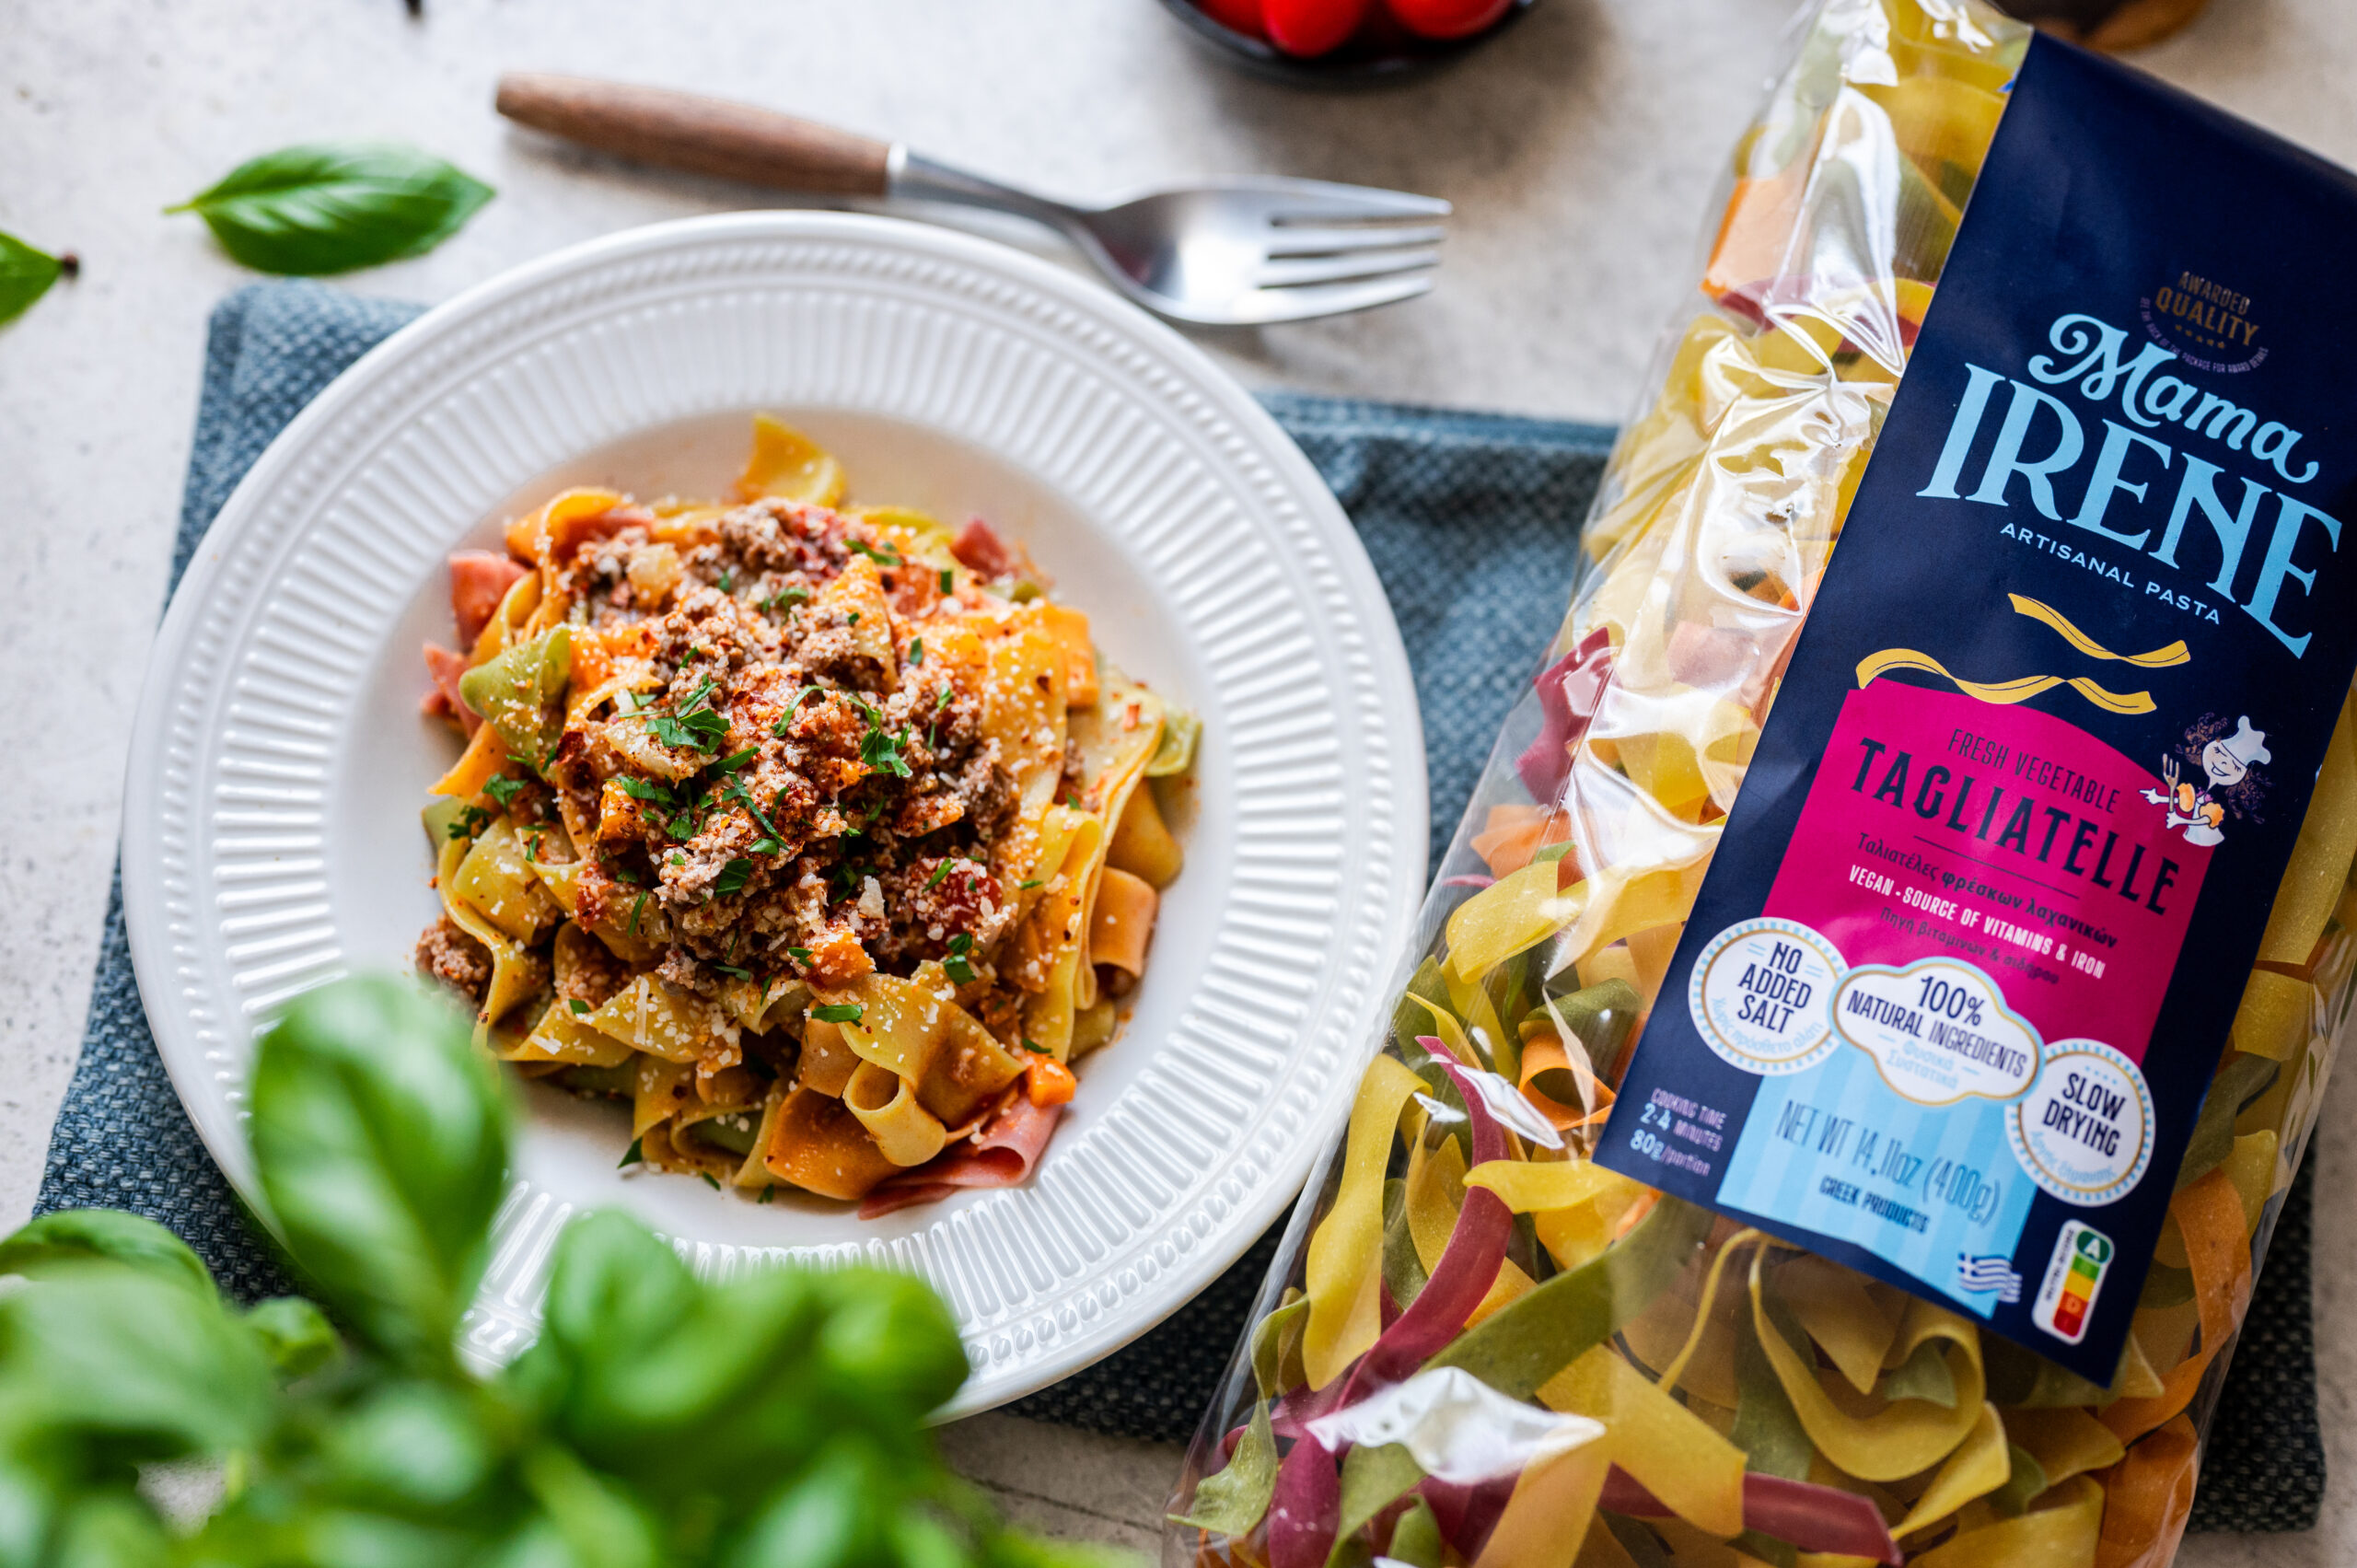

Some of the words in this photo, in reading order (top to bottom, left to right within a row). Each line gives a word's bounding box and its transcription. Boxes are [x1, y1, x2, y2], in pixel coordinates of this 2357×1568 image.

[2155, 287, 2259, 346] QUALITY
[2178, 271, 2250, 315] AWARDED
[2027, 313, 2319, 483] Mama
[1915, 363, 2343, 660] IRENE
[2001, 522, 2135, 588] ARTISANAL
[2145, 581, 2221, 624] PASTA
[1947, 727, 2008, 771] FRESH
[2015, 750, 2120, 814] VEGETABLE
[1851, 737, 2180, 916] TAGLIATELLE
[1856, 831, 1938, 881] Ταλιατέλες
[1941, 870, 2024, 910] φρέσκων
[2026, 898, 2118, 949] λαχανικών
[1848, 865, 1895, 897] VEGAN
[1902, 887, 1958, 921] SOURCE
[1960, 908, 1981, 928] OF
[1983, 915, 2053, 956] VITAMINS
[2055, 944, 2068, 962] &
[2071, 950, 2107, 979] IRON
[1768, 941, 1803, 974] NO
[1989, 947, 2000, 961] &
[1737, 963, 1812, 1008] ADDED
[1918, 976, 1984, 1027] 100%
[1737, 994, 1794, 1033] SALT
[1847, 990, 1923, 1038] NATURAL
[1928, 1019, 2028, 1078] INGREDIENTS
[1650, 1087, 1699, 1119] COOKING
[1698, 1105, 1727, 1130] TIME
[2062, 1073, 2126, 1121] SLOW
[1673, 1120, 1724, 1152] MINUTES
[2042, 1098, 2120, 1156] DRYING
[1775, 1099, 1819, 1147] NET
[1817, 1113, 1854, 1159] WT
[1852, 1127, 1922, 1189] 14.11oz
[1922, 1156, 2001, 1228] (400g)
[1862, 1191, 1931, 1235] PRODUCTS
[2084, 1237, 2101, 1259] A
